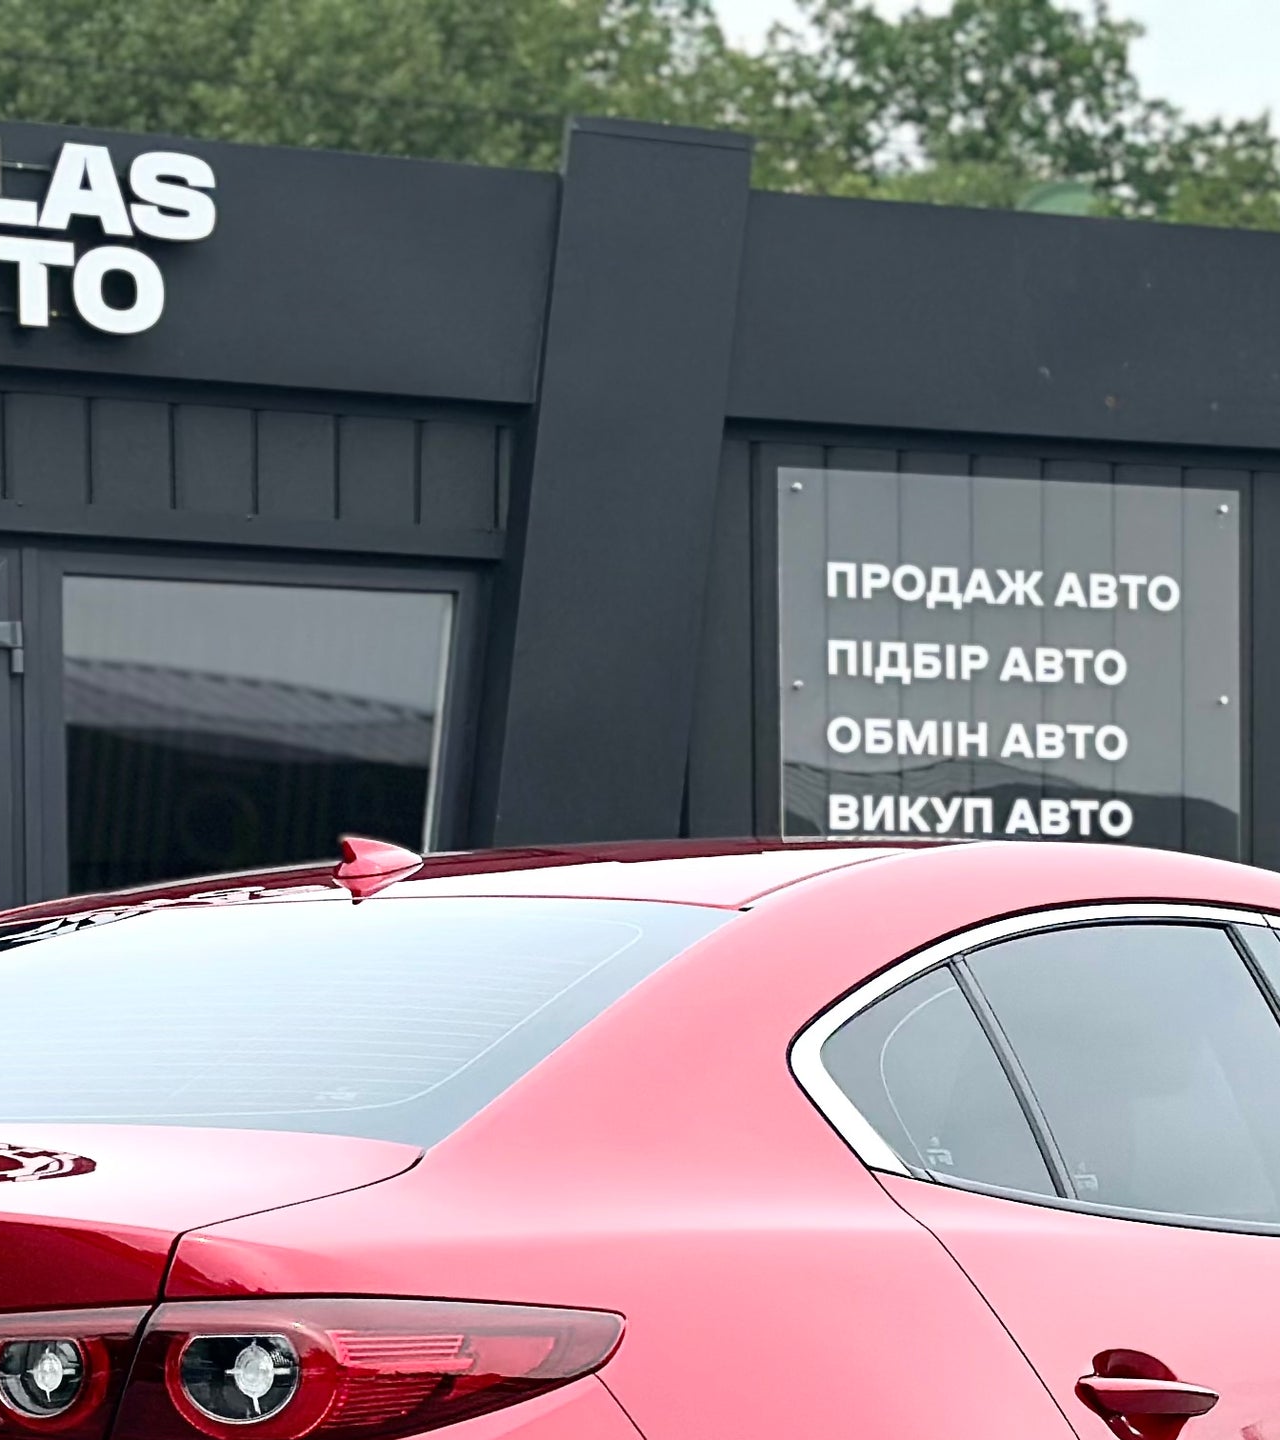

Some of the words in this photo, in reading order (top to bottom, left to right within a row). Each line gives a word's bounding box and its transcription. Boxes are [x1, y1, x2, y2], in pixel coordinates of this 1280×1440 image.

[827, 562, 1043, 609] ПРОДАЖ
[1054, 573, 1180, 612] АВТО
[827, 640, 989, 684] ПІДБІР
[1000, 647, 1128, 685] АВТО
[827, 717, 988, 757] ОБМІН
[1001, 724, 1128, 761] АВТО
[829, 795, 992, 832] ВИКУП
[1005, 799, 1133, 837] АВТО
